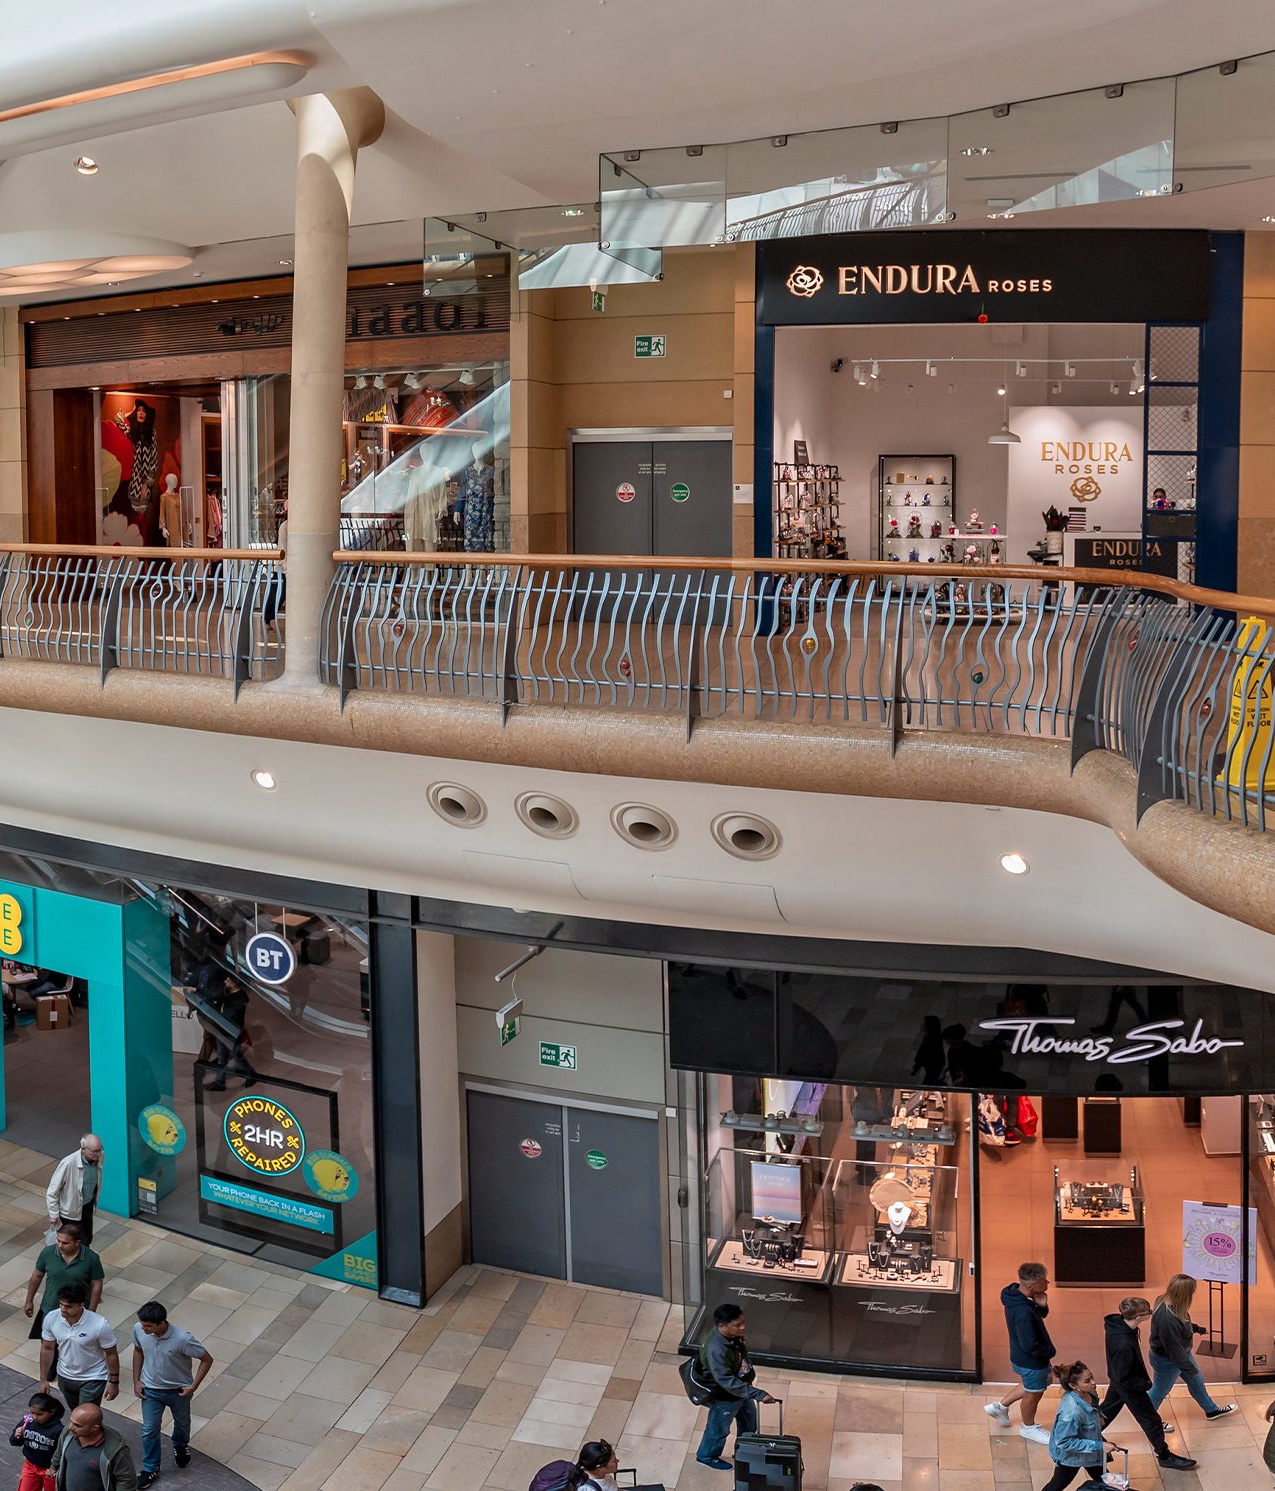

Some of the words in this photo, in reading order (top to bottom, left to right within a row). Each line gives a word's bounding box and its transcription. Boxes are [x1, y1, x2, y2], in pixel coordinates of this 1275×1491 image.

[838, 264, 980, 295] ENDURA
[988, 279, 1052, 293] ROSES
[1041, 441, 1133, 463] ENDURA
[1055, 464, 1119, 475] ROSES
[1247, 720, 1271, 728] FLOR
[256, 947, 283, 971] BT
[541, 1047, 556, 1055] Fire
[979, 1018, 1114, 1061] Thomas
[1107, 1018, 1245, 1064] Sabo
[542, 1054, 556, 1062] exit
[234, 1100, 294, 1129] PHONES
[243, 1124, 284, 1149] 2HR
[231, 1136, 297, 1172] REPAIRED
[208, 1182, 230, 1194] YOUR
[230, 1188, 257, 1201] PHONE
[258, 1196, 280, 1208] BACK
[281, 1202, 290, 1210] IN
[299, 1206, 325, 1220] FLASH
[213, 1191, 254, 1209] WHATEVER
[254, 1201, 278, 1215] YOUR
[278, 1208, 320, 1225] NETWORK
[1209, 1237, 1232, 1249] 15%
[343, 1253, 376, 1273] BIG
[728, 1286, 767, 1300] Thomas
[765, 1292, 804, 1302] Sabo
[858, 1301, 897, 1314] Thomas
[895, 1304, 936, 1315] Sabo
[23, 1429, 55, 1447] OSTON
